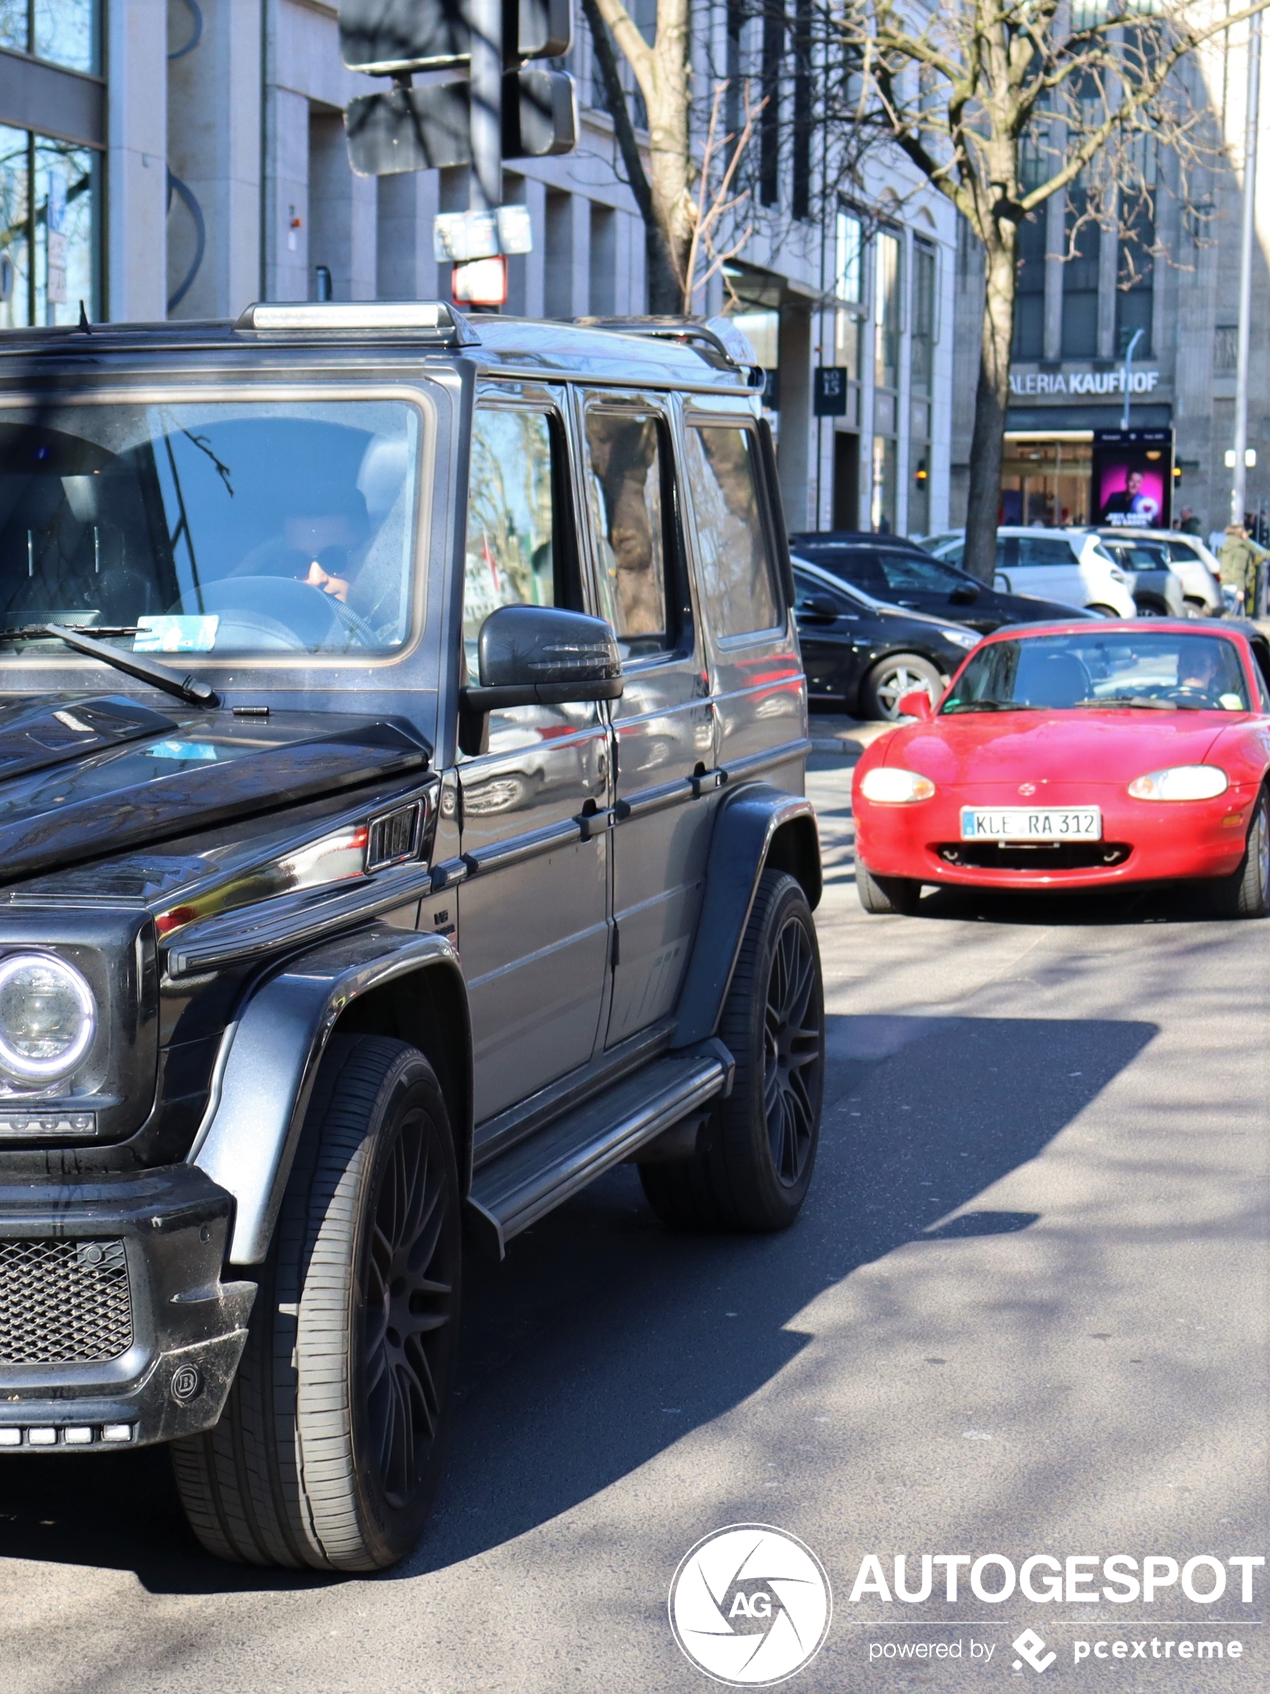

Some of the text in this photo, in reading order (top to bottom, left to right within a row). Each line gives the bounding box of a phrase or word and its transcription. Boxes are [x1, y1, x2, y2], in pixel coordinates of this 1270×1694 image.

[1009, 373, 1067, 394] ALERIA
[976, 816, 1012, 834] KLE
[1028, 815, 1052, 834] RA
[1059, 814, 1095, 834] 312
